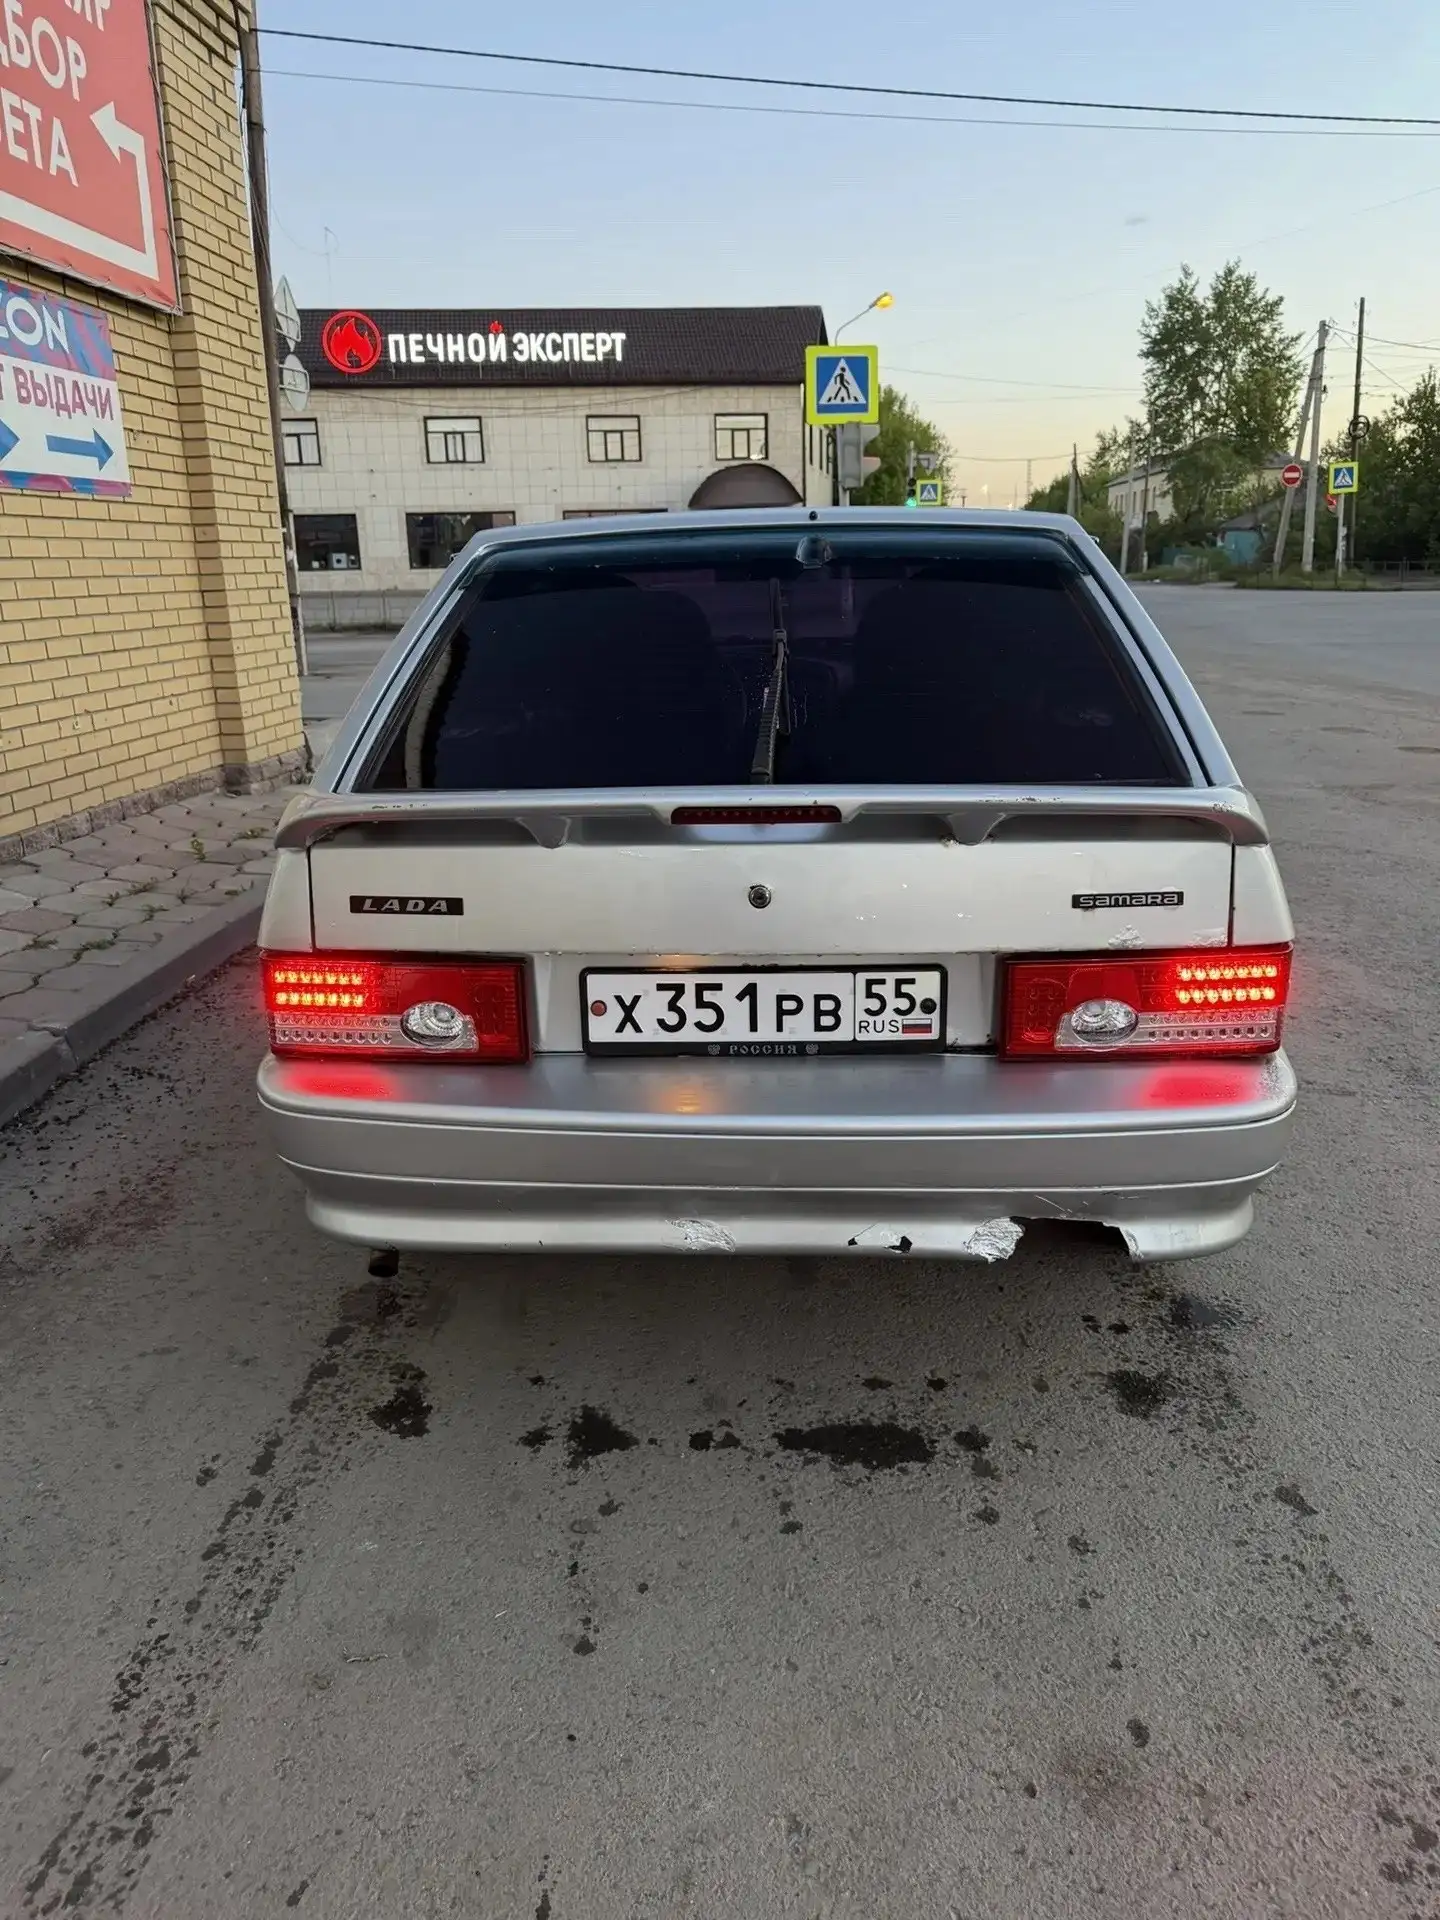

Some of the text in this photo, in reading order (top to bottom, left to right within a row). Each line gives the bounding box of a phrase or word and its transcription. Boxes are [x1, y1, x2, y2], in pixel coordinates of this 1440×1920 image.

[0, 87, 79, 188] ЕТА
[387, 321, 626, 363] ПЕЧНОЙ ЭКСПЕРТ
[12, 366, 114, 421] ВЫДАЧИ
[362, 898, 448, 912] LADA
[863, 978, 917, 1017] 55
[858, 1020, 900, 1035] RUS
[728, 1044, 798, 1055] РОССИЯ
